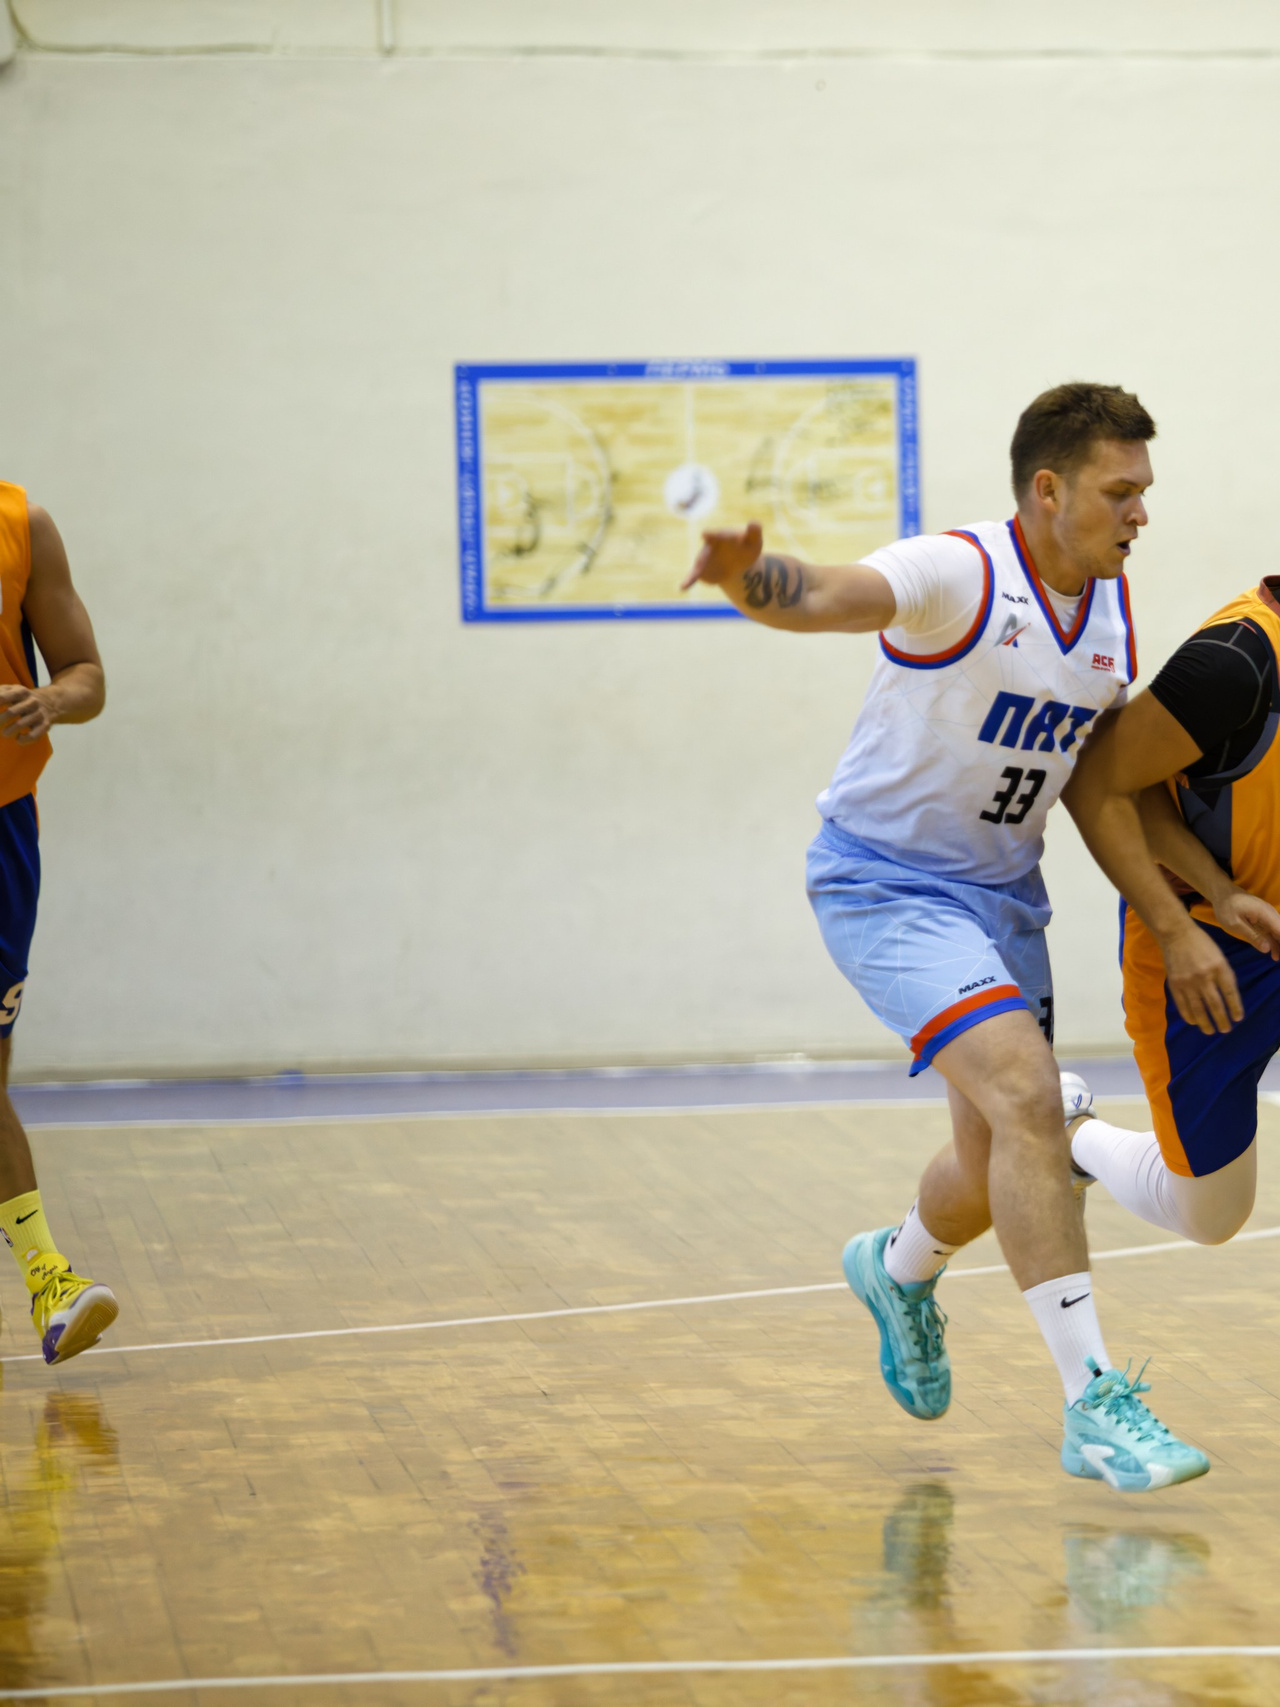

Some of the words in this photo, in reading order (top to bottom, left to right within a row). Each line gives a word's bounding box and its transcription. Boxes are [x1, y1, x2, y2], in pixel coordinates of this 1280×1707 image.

[1001, 591, 1029, 605] MAXX
[979, 766, 1047, 824] 33
[958, 976, 996, 994] MAXX
[1039, 996, 1053, 1044] 3
